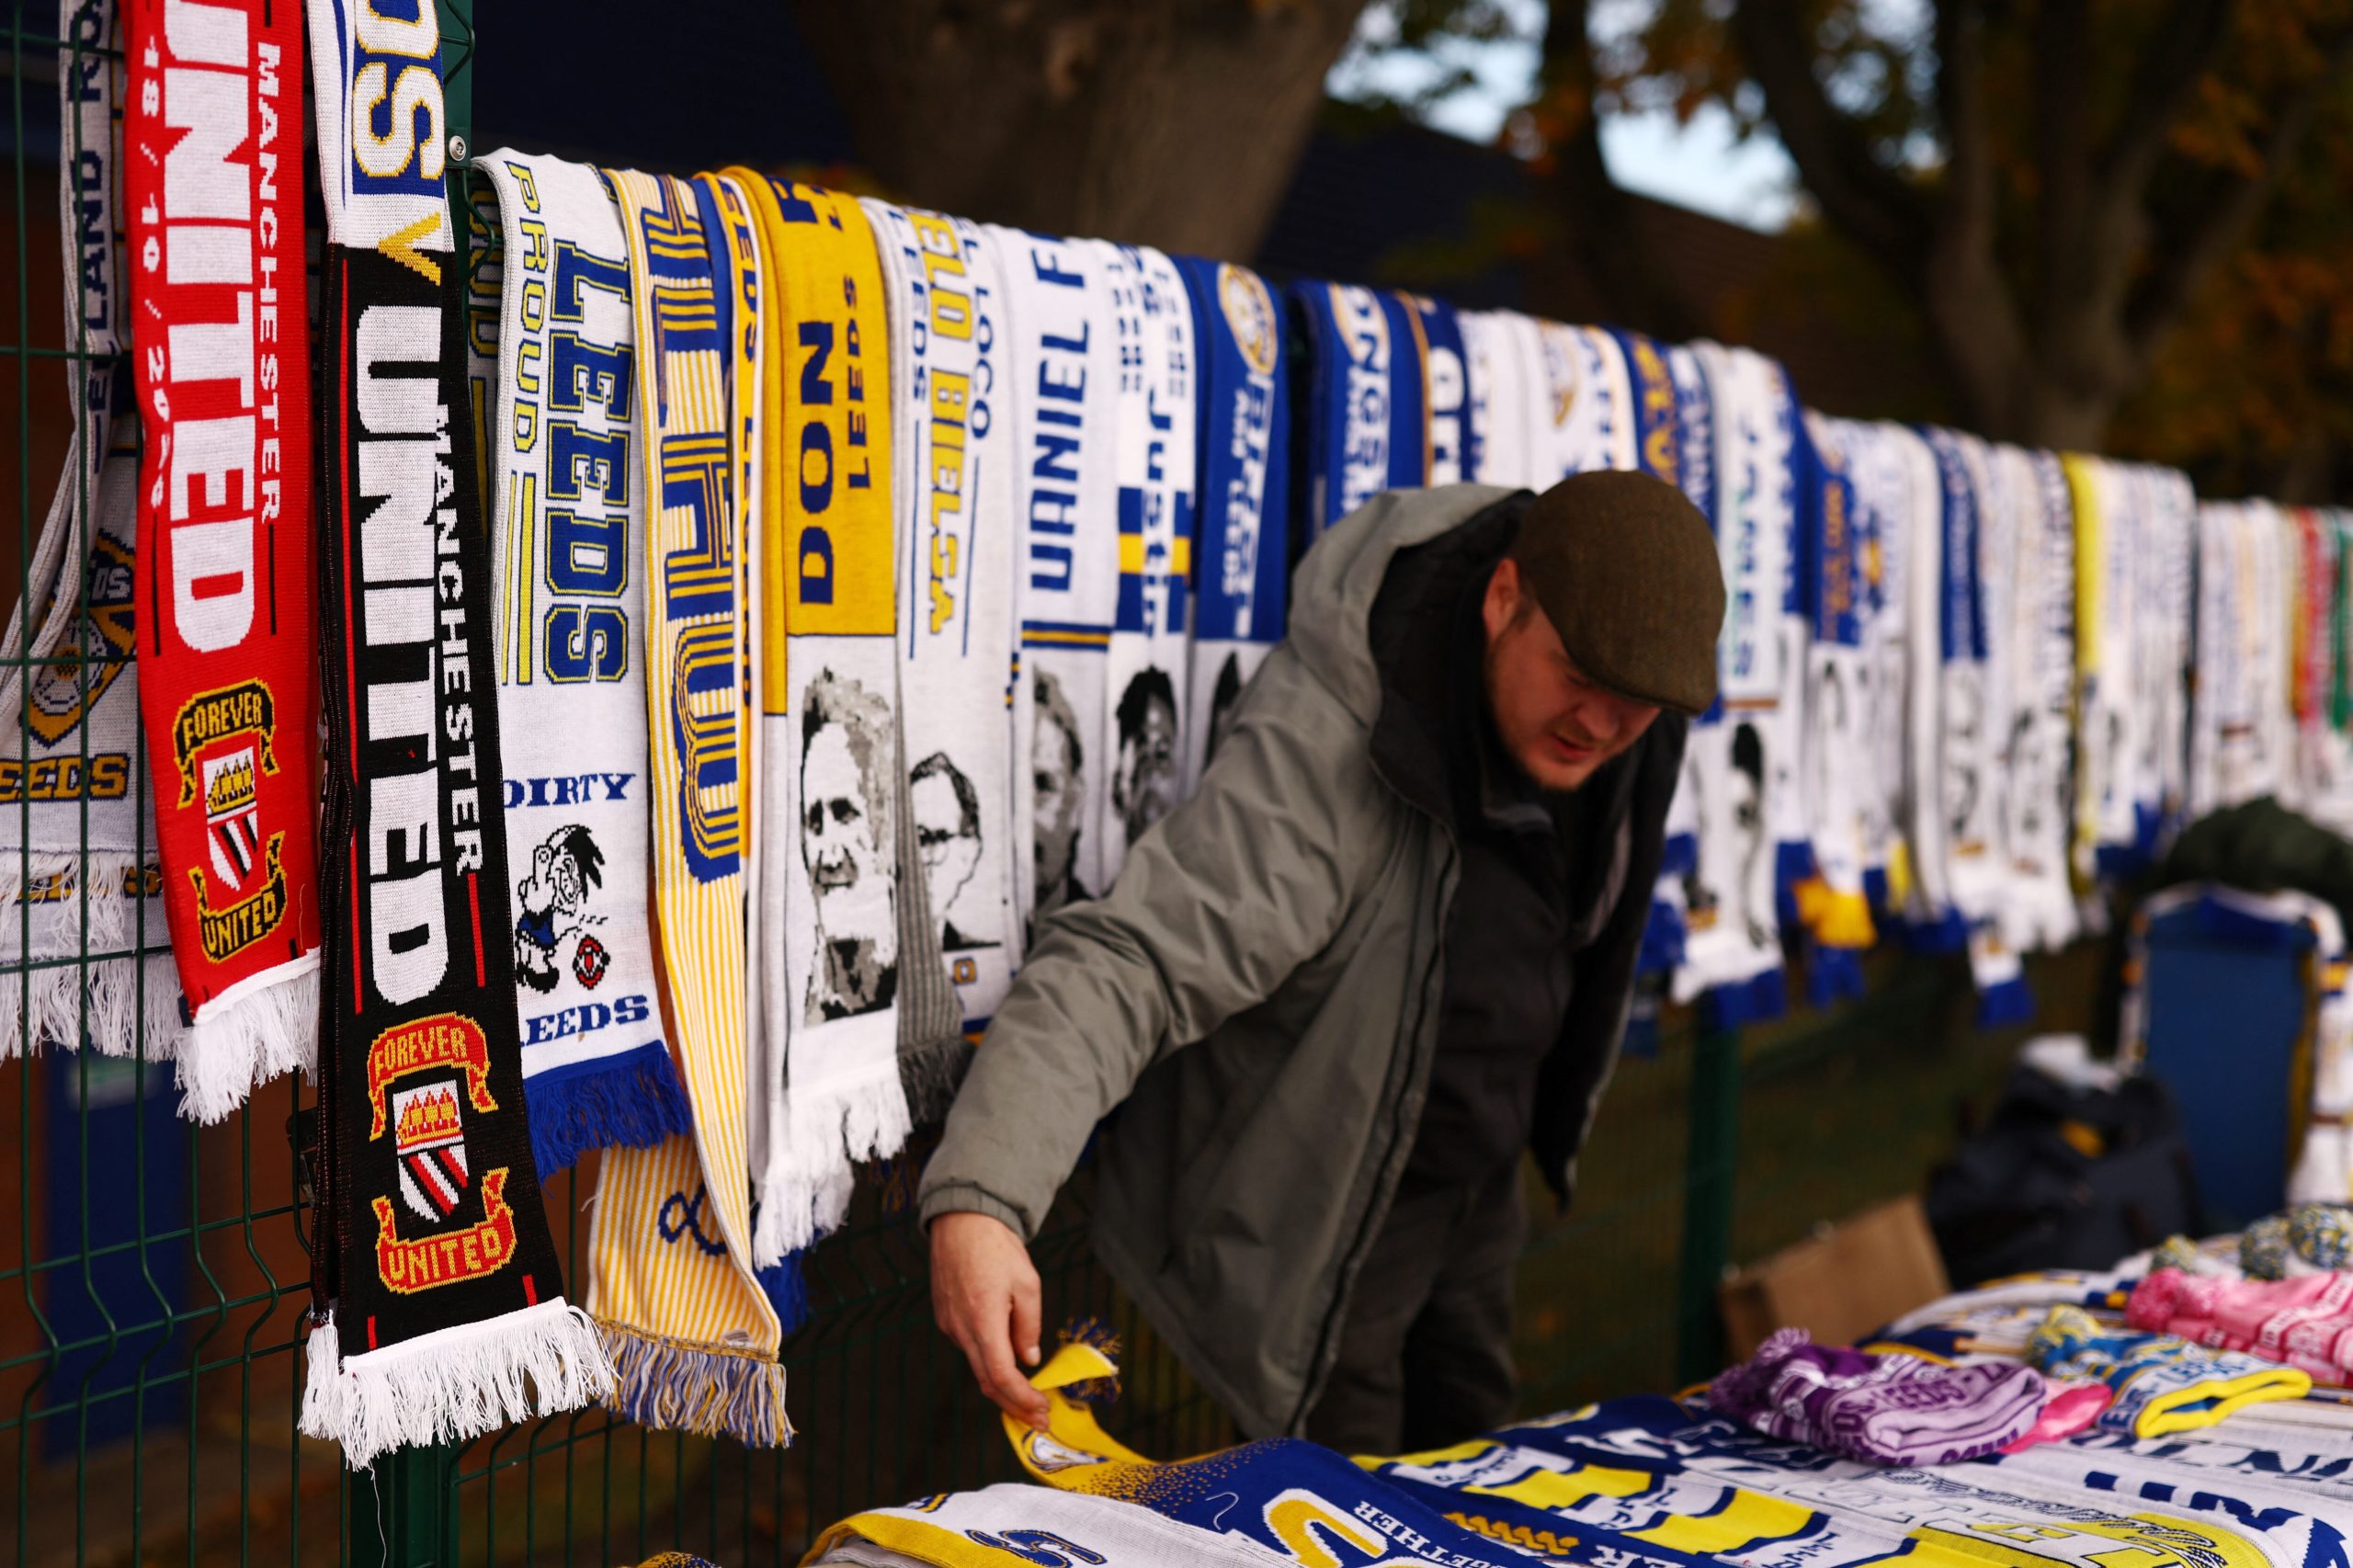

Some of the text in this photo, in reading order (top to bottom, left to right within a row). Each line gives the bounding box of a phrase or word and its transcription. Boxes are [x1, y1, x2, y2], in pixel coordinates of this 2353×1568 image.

[257, 42, 280, 525] MANCHESTER
[505, 160, 549, 453] PROUD
[842, 274, 871, 491] LEEDS
[971, 286, 995, 441] LOCO
[543, 239, 635, 684] LEEDS
[798, 321, 835, 607] DON
[930, 368, 971, 634] BIELSA
[184, 692, 264, 741] FOREVER
[356, 306, 449, 1006] UNITED
[434, 404, 483, 876] MANCHESTER
[503, 772, 638, 809] DIRTY
[203, 892, 278, 955] UNITED
[521, 994, 649, 1047] EEDS
[375, 1025, 467, 1075] FOREVER
[388, 1226, 503, 1285] UNITED
